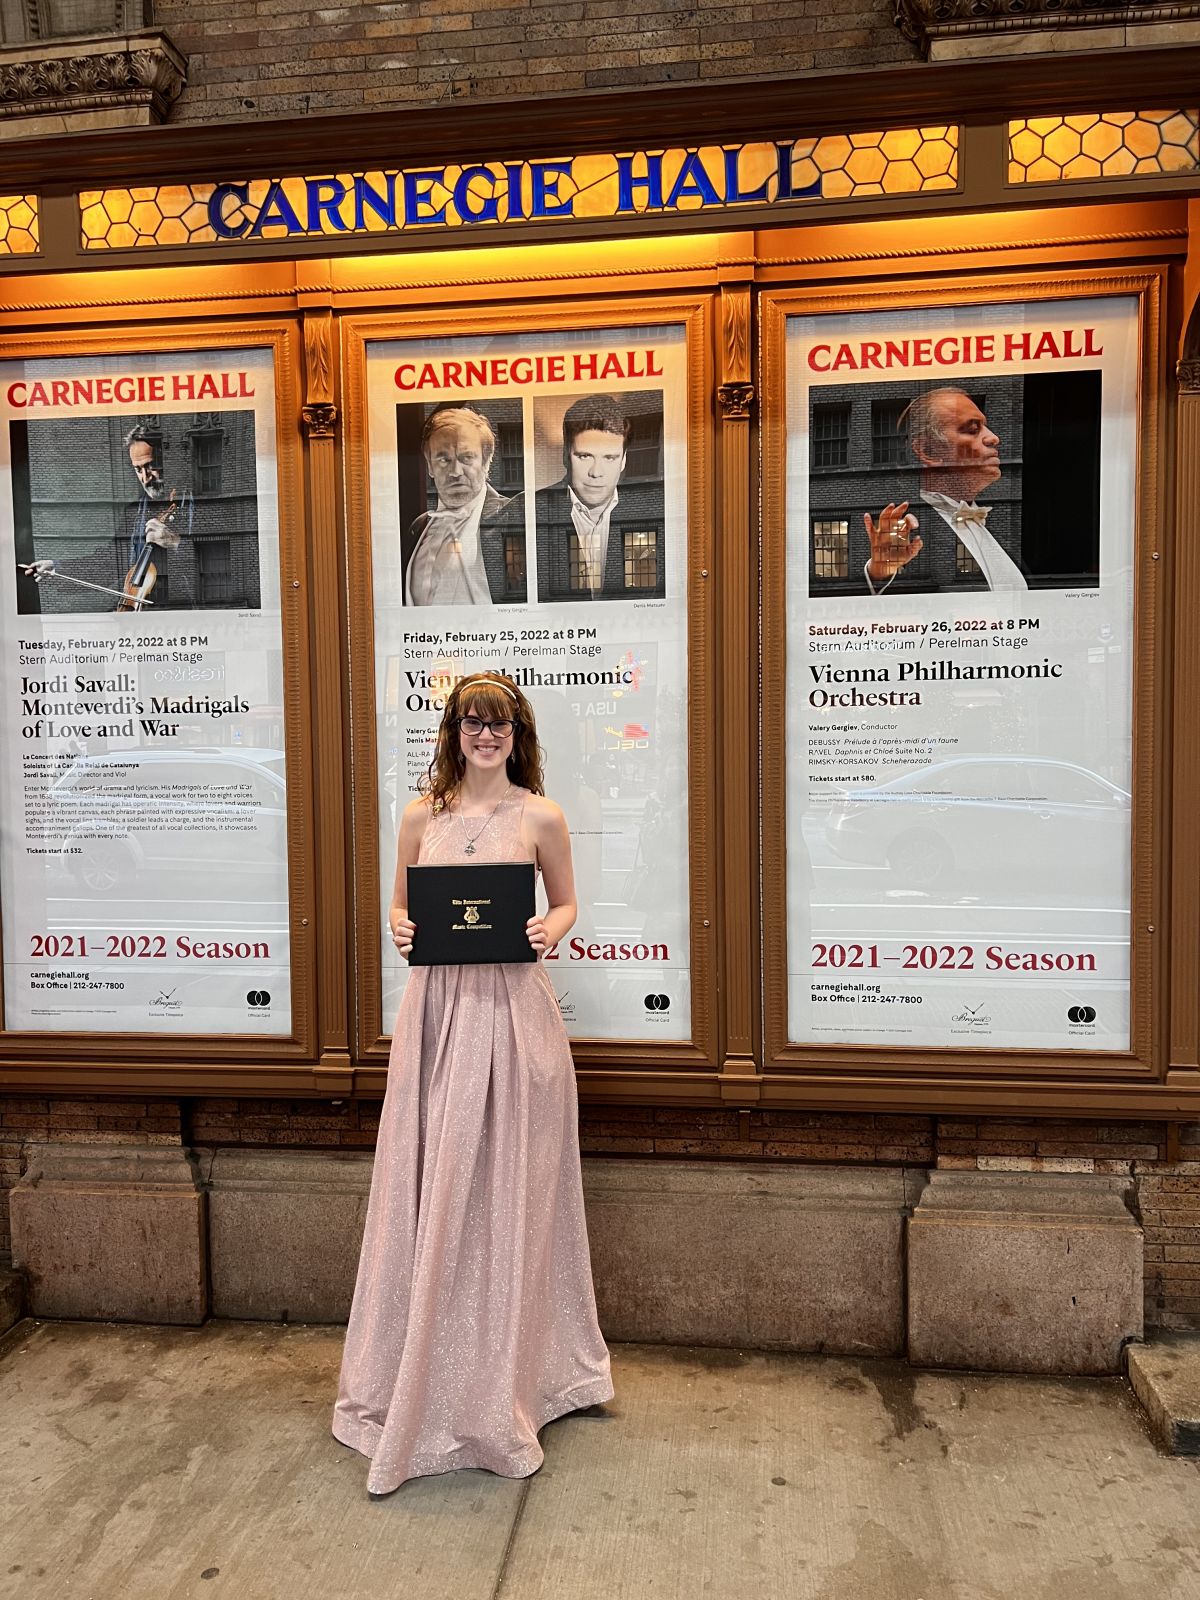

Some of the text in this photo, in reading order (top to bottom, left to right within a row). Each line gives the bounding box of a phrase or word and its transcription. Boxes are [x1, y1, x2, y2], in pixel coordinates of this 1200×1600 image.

[207, 140, 823, 239] CARNEGIE HALL
[808, 329, 1104, 372] CARNEGIE HALL
[394, 351, 663, 391] CARNEGIE HALL
[8, 373, 255, 408] CARNEGIE HALL
[403, 628, 597, 644] Friday, February 25, 2022 at 8 PM
[809, 619, 1040, 636] Saturday, February 26, 2022 at 8 PM
[18, 636, 208, 651] Tuesday, February 22, 2022 at 8 PM
[404, 648, 433, 659] Stern
[436, 646, 501, 658] Auditorium
[513, 646, 566, 656] Perelman
[569, 645, 602, 657] Stage
[808, 642, 841, 652] Stern
[844, 640, 915, 651] Auditorium
[929, 637, 988, 649] Perelman
[992, 636, 1028, 649] Stage
[19, 654, 46, 665] Stern
[49, 653, 109, 664] Auditorium
[119, 652, 169, 662] Perelman
[172, 651, 203, 664] Stage
[808, 658, 1063, 683] Vienna Philharmonic
[21, 674, 135, 695] Jordi Savall:
[150, 695, 249, 718] Madrigals
[809, 687, 922, 707] Orchestra
[22, 719, 180, 738] of Love and War
[176, 936, 271, 958] Season
[569, 937, 670, 960] Season
[985, 947, 1097, 971] Season
[30, 971, 90, 980] carnegiehall.org
[811, 983, 881, 993] carnegiehall.org
